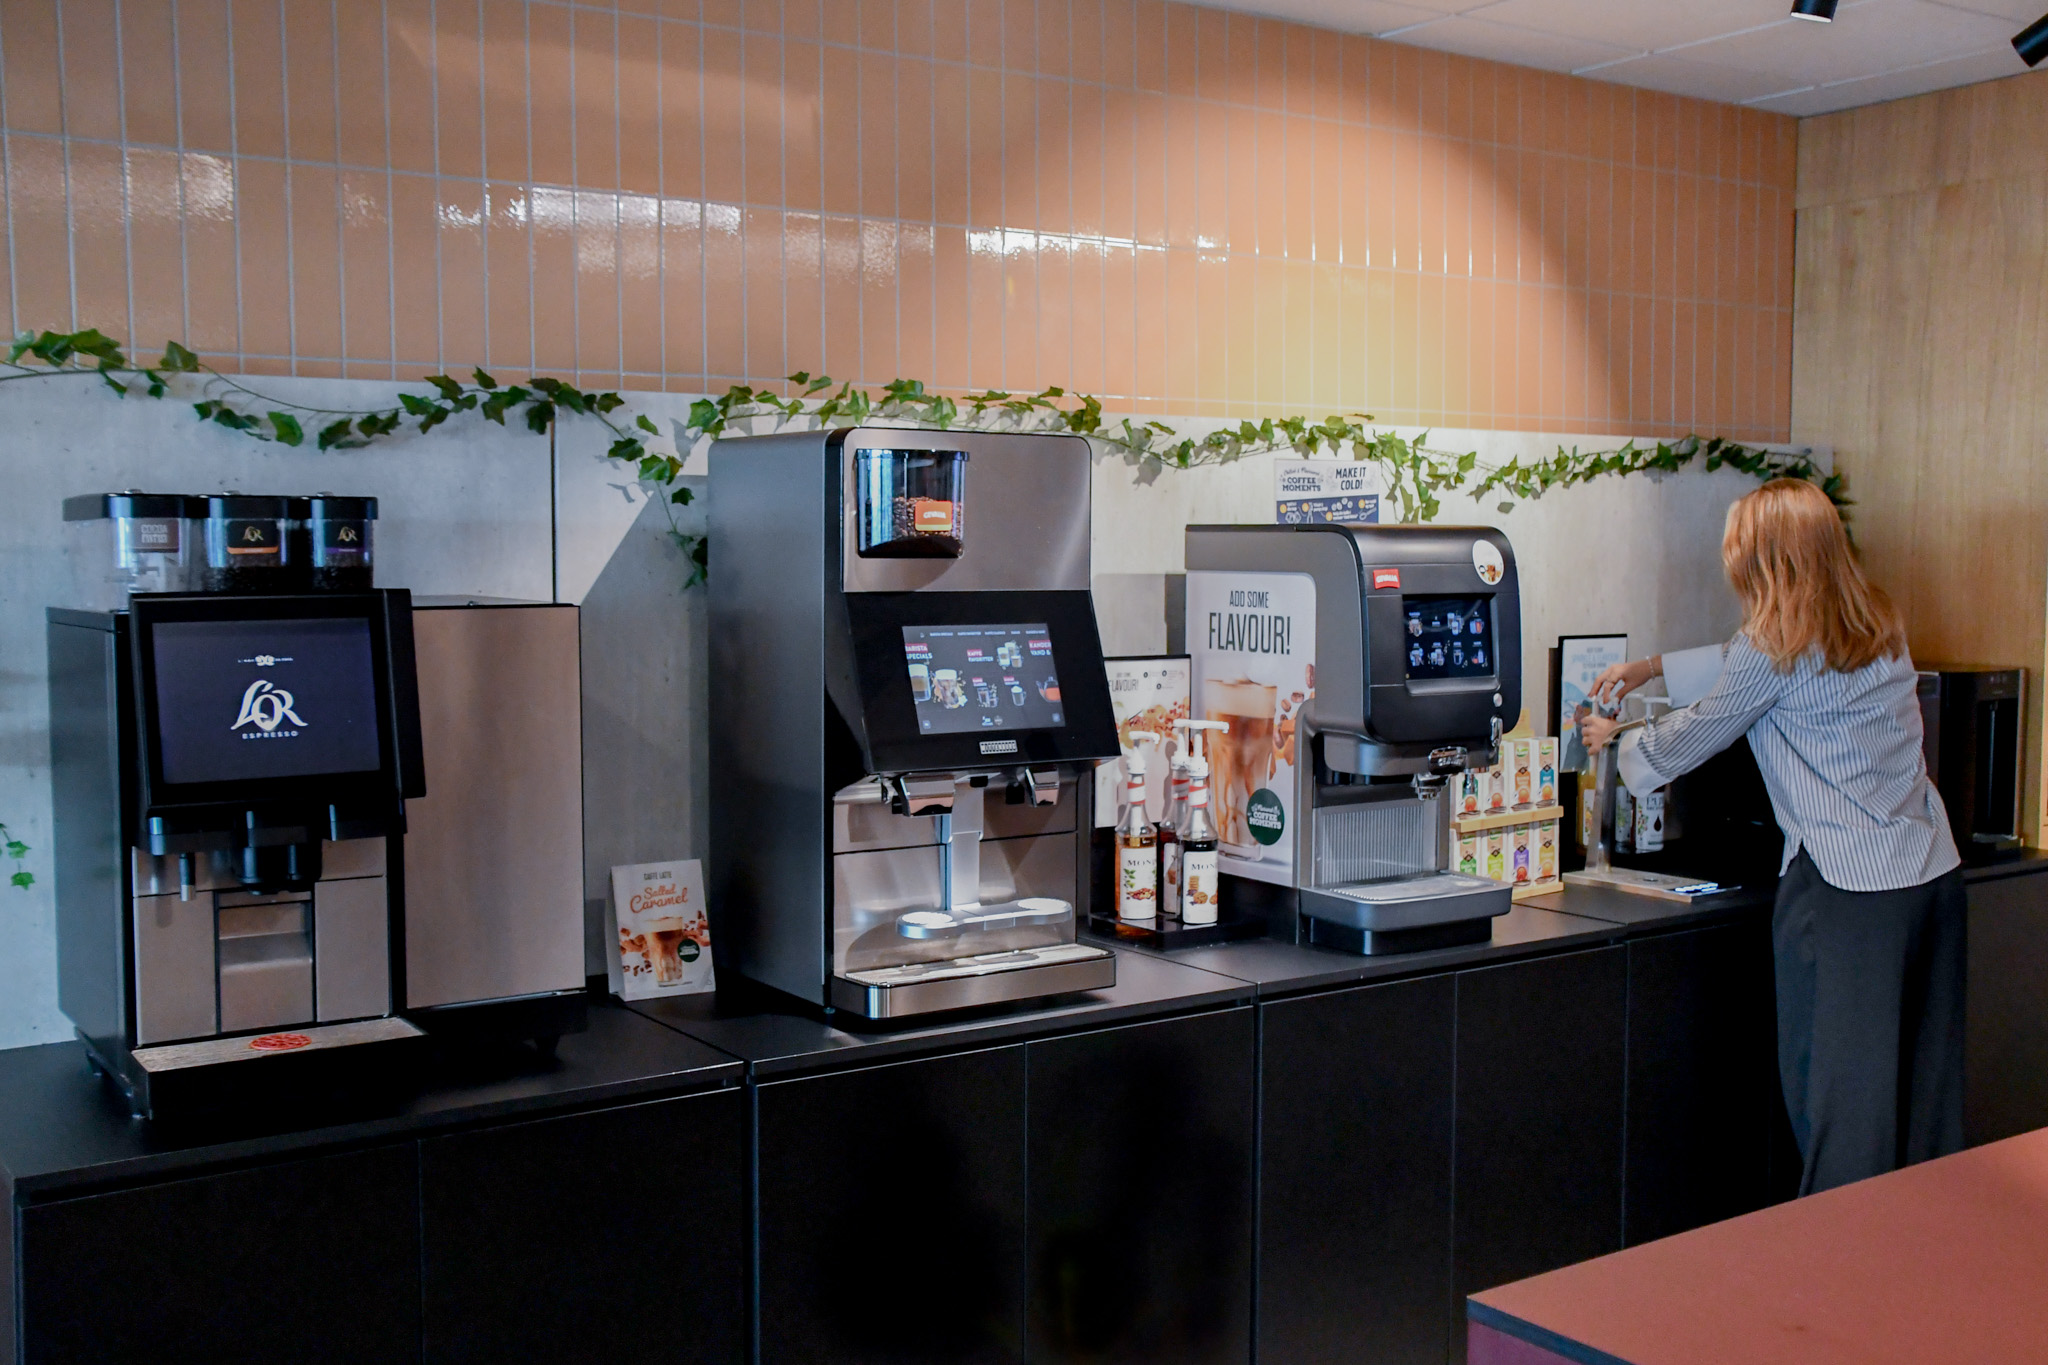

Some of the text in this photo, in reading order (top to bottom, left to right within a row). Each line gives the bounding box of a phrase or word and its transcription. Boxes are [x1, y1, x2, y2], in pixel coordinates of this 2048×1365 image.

[1335, 466, 1367, 479] MAKE IT
[1282, 484, 1321, 492] MOMENTS
[1340, 479, 1363, 491] COLD!
[1229, 590, 1269, 608] ADD SOME
[1208, 612, 1291, 656] FLAVOUR!
[242, 730, 299, 740] ESPRESSO
[630, 887, 688, 913] Caramel
